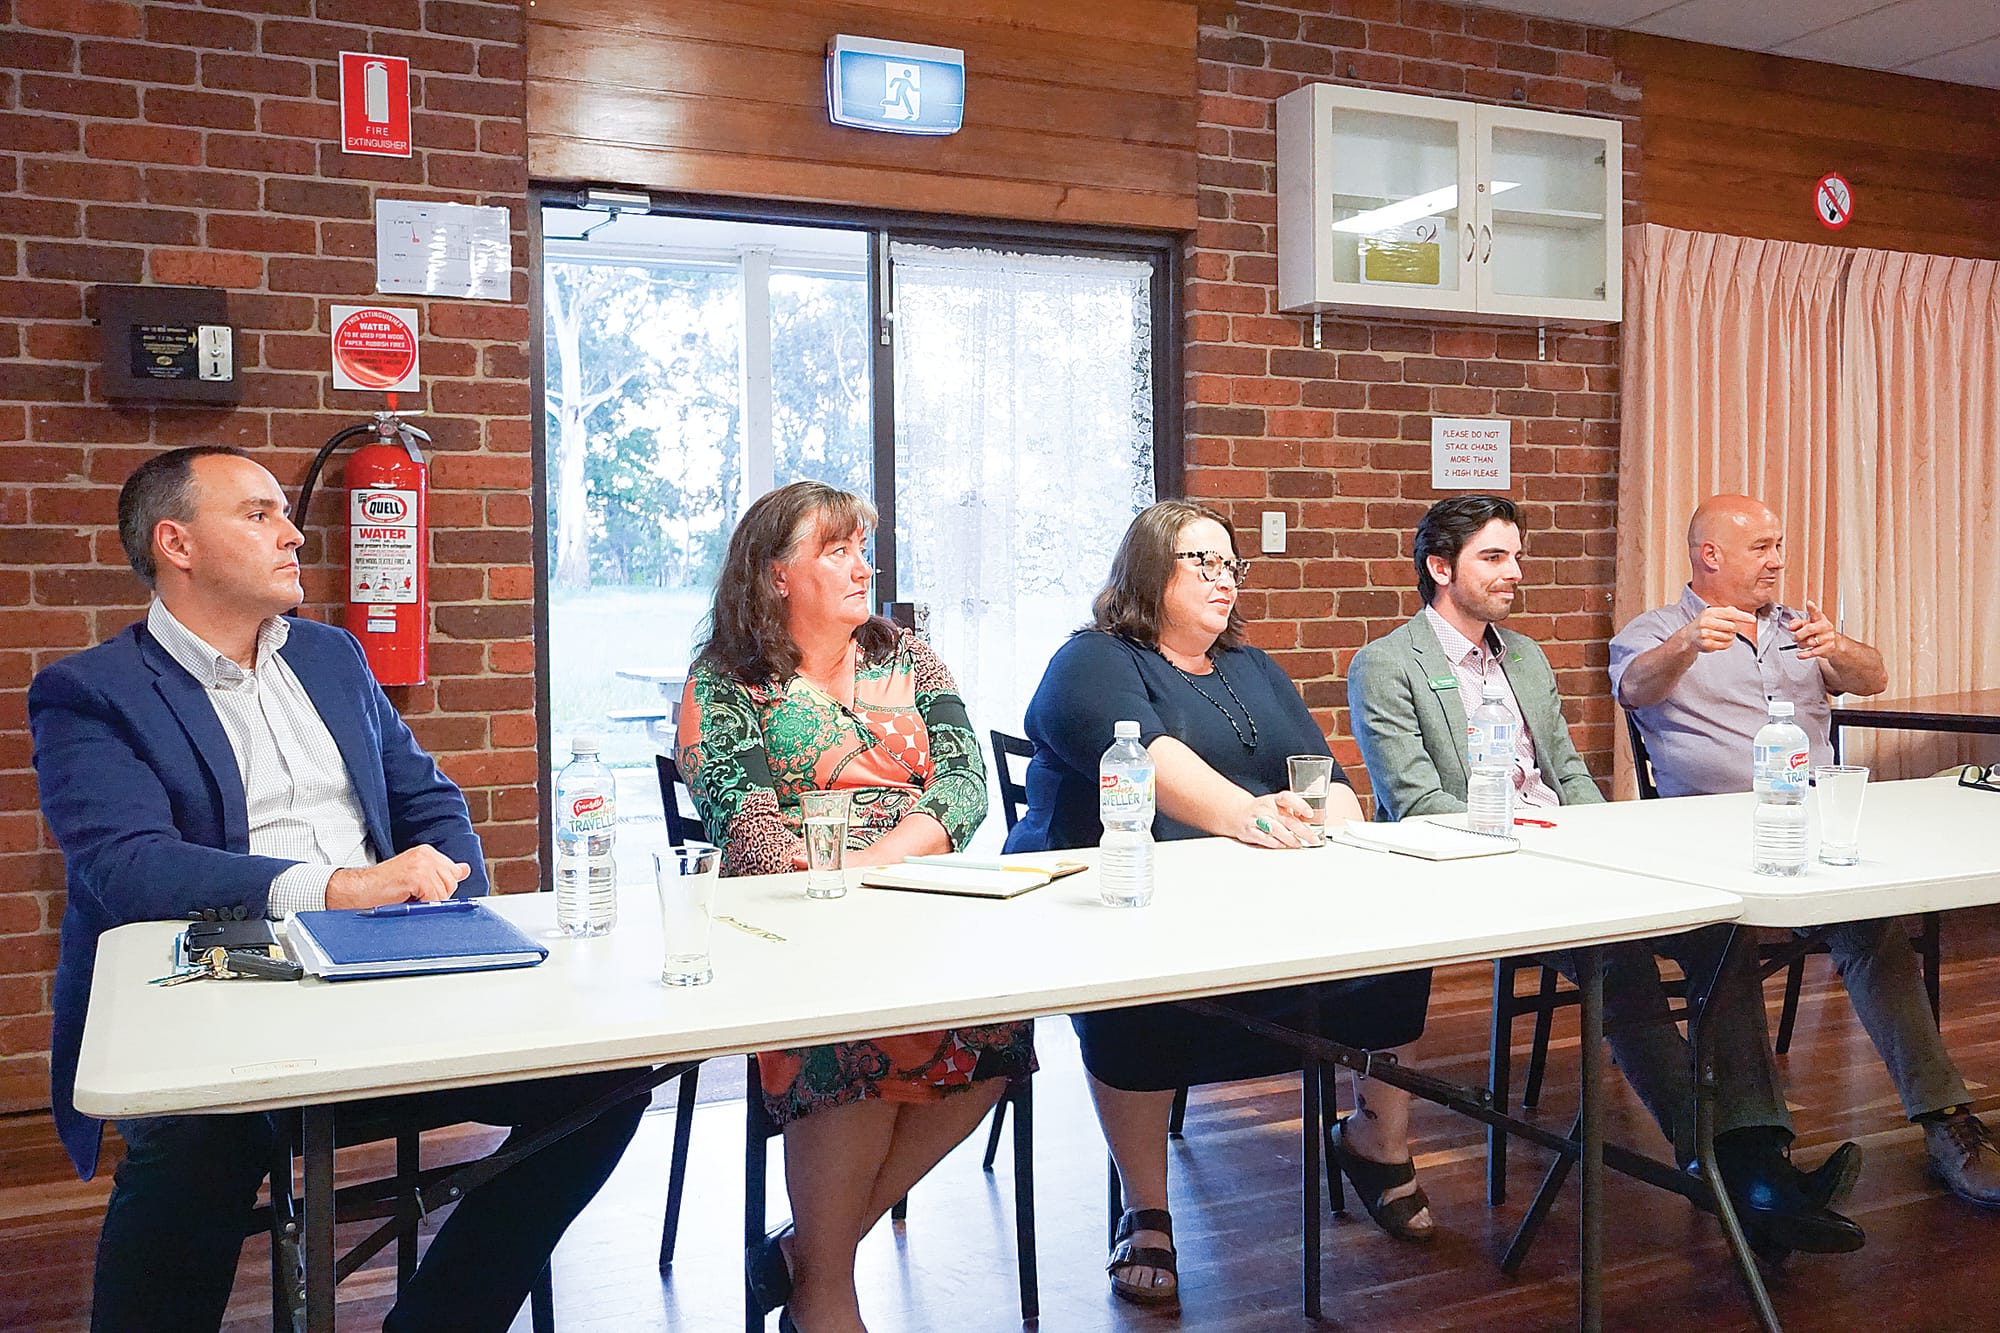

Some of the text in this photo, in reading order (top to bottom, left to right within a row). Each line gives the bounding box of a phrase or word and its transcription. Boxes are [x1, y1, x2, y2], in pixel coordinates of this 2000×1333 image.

[365, 126, 389, 136] FIRE
[347, 137, 407, 150] EXTINGUISHER
[359, 322, 390, 331] WATER
[1442, 430, 1500, 439] PLEASE DO NOT
[1452, 469, 1471, 477] HIGH
[1473, 469, 1499, 477] PLEASE
[369, 501, 400, 515] QUELL
[359, 528, 406, 539] WATER
